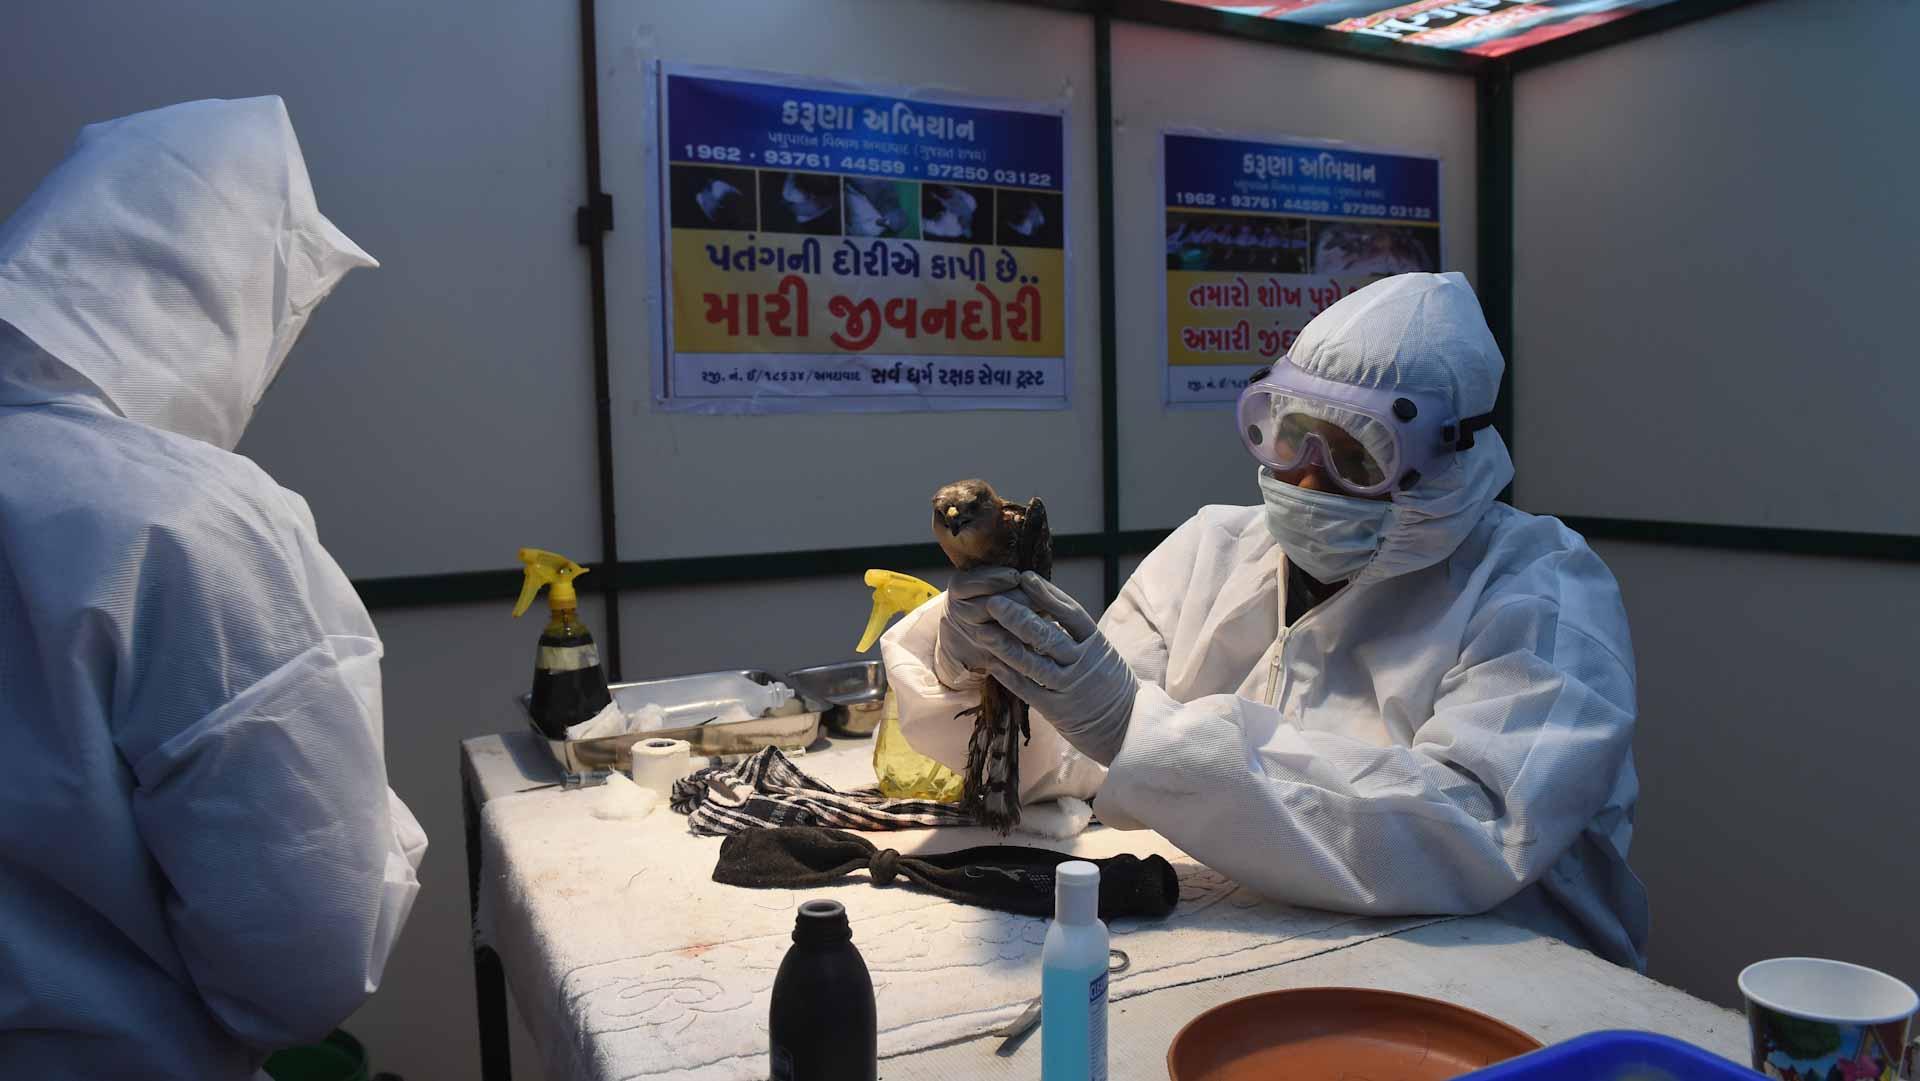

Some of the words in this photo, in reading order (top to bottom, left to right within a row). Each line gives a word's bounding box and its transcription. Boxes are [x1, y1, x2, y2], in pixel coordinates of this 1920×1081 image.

[782, 100, 853, 132] કરૂણા
[863, 103, 975, 141] અભિયાન
[684, 144, 741, 161] 1962
[764, 150, 830, 168] 93761
[840, 156, 905, 174] 44559
[927, 163, 988, 181] 97250
[993, 169, 1051, 187] 03122
[1243, 153, 1293, 180] કરૂણા
[1299, 152, 1376, 183] અભિયાન
[1176, 192, 1216, 206] 1962
[705, 234, 821, 275] પતંગની
[832, 239, 920, 277] દોરીએ
[930, 246, 986, 281] કાપી
[996, 248, 1040, 284] છે..
[1189, 277, 1248, 308] તમારો
[1257, 278, 1300, 307] શોખ
[703, 274, 809, 337] મારી
[828, 282, 1041, 351] જીવનદોરી
[1183, 320, 1249, 351] અમારી
[702, 370, 726, 385] રજી.
[871, 362, 902, 384] સર્વ
[906, 362, 934, 385] ધર્મ
[938, 368, 974, 387] રક્ષક
[978, 364, 1011, 386] સેવા
[1016, 370, 1045, 389] ટ્રસ્ટ
